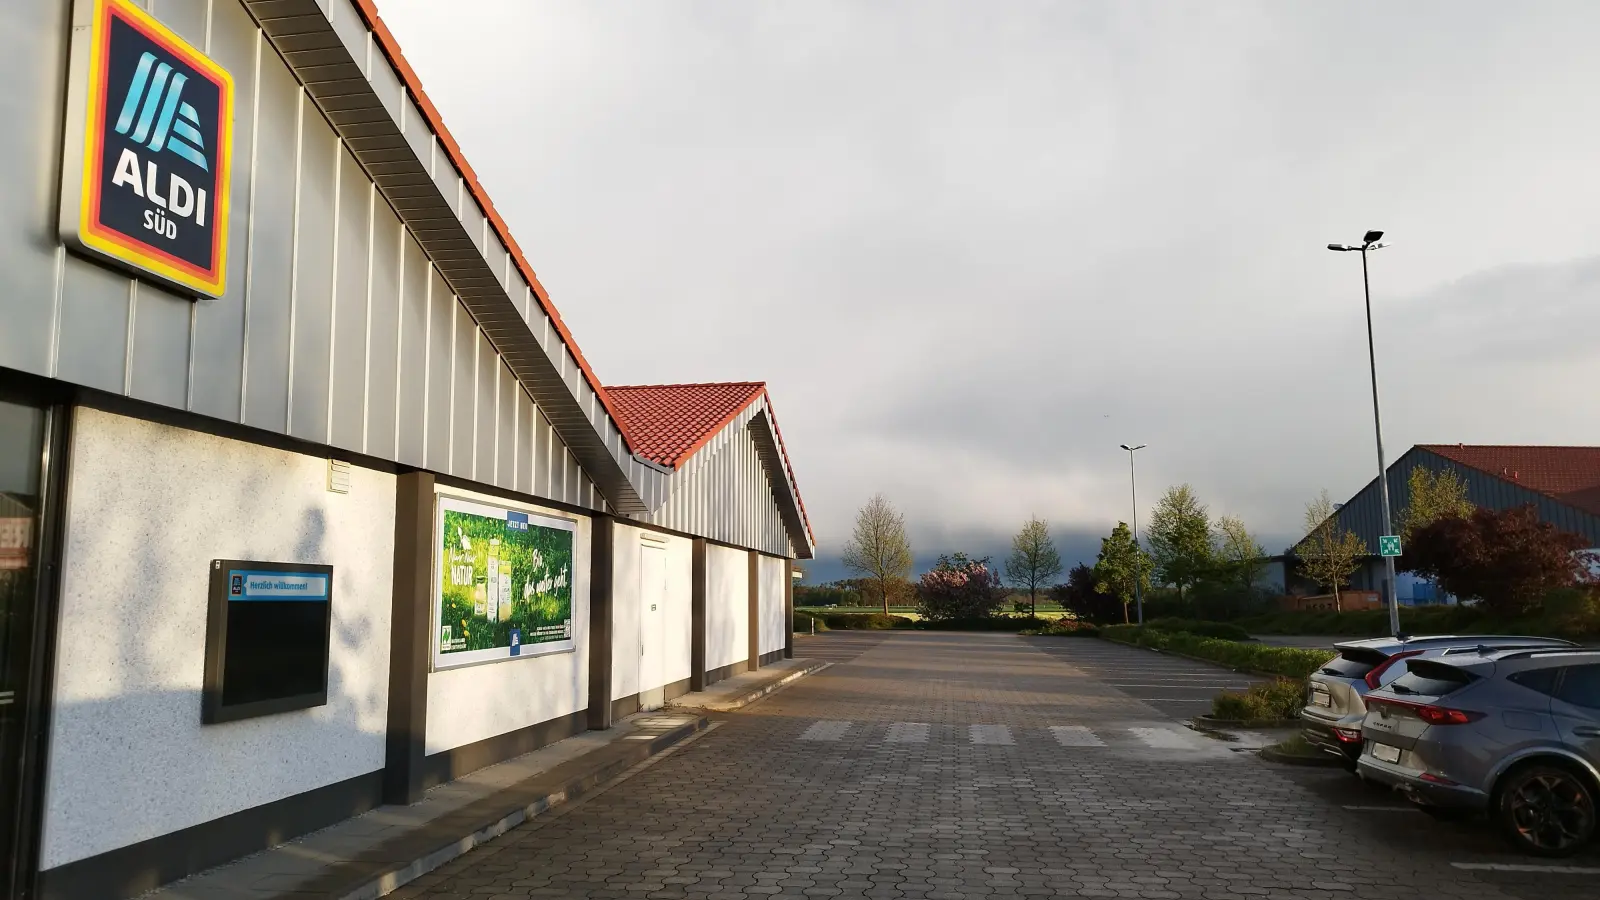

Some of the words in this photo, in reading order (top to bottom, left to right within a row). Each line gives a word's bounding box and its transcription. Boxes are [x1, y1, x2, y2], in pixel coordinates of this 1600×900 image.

[112, 147, 207, 227] ALDI
[143, 207, 177, 240] SÜD
[250, 580, 273, 590] Herzlich
[274, 580, 308, 591] willkommen!
[451, 564, 473, 586] NATUR
